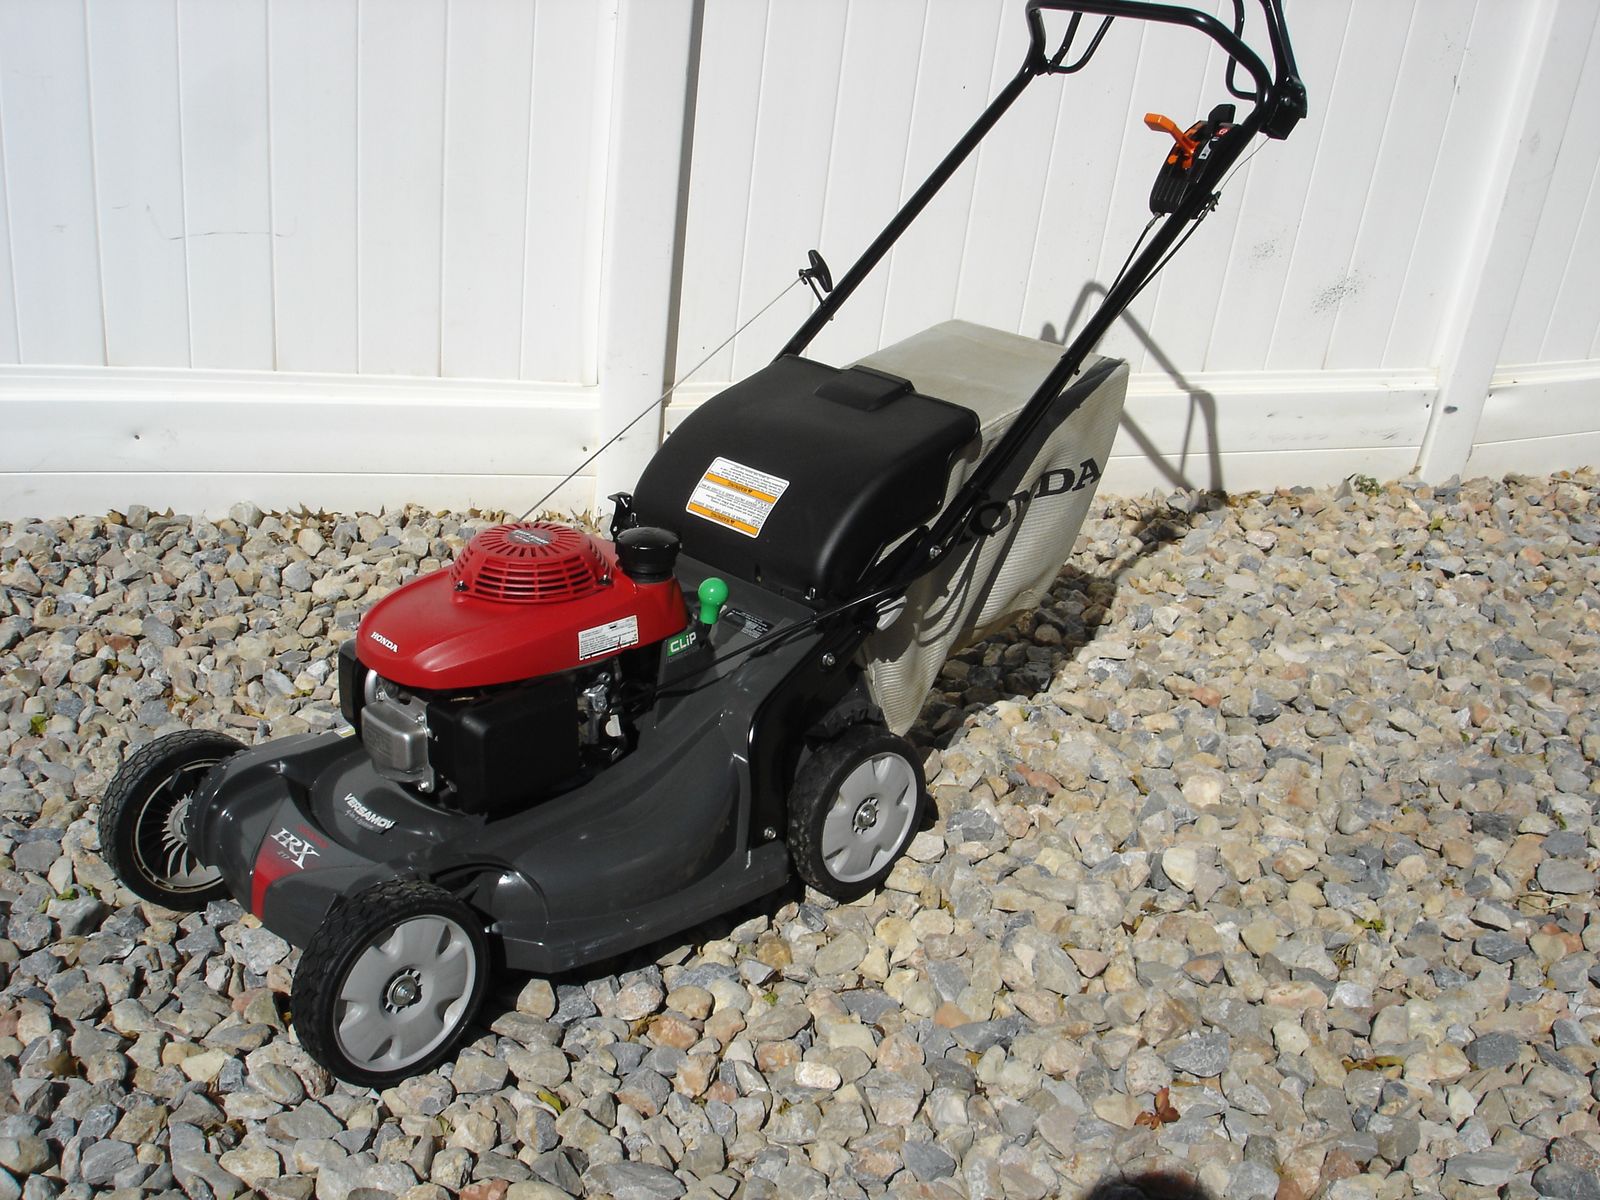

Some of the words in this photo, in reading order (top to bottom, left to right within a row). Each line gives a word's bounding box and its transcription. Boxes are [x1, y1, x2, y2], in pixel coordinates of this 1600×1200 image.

[958, 458, 1101, 545] ONDA
[370, 631, 399, 653] HONDA
[270, 827, 321, 870] HRX
